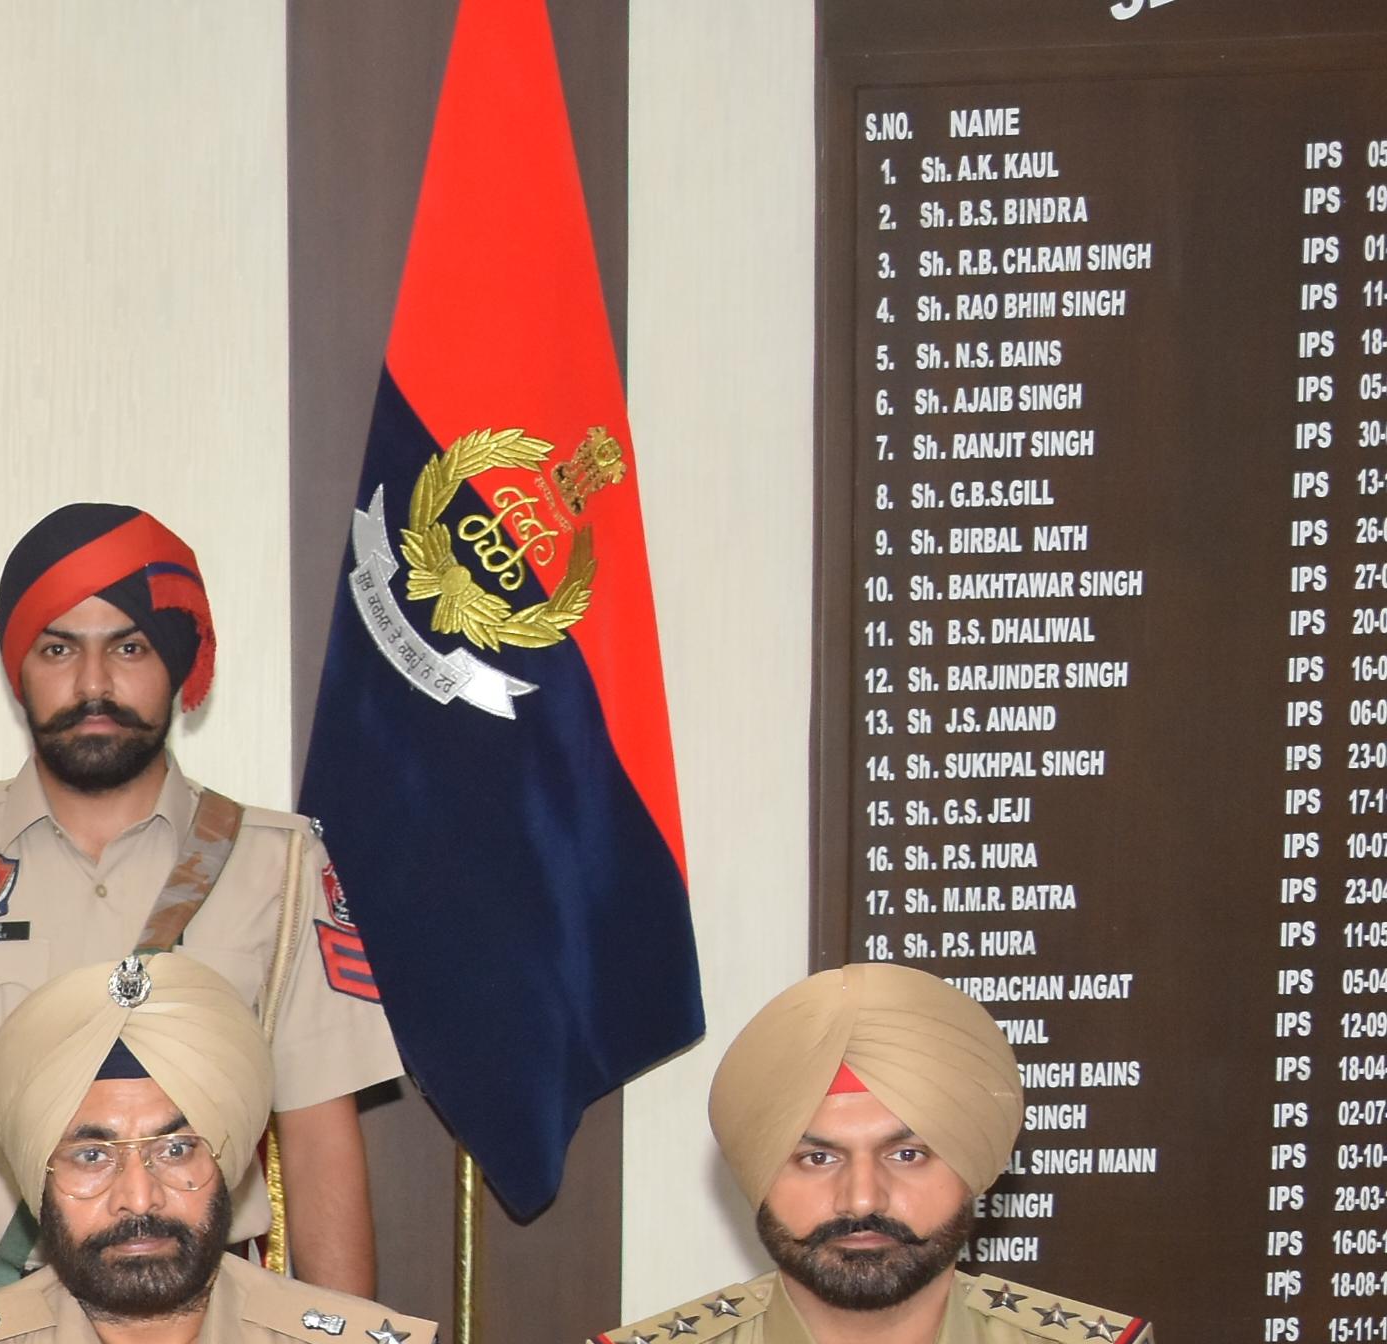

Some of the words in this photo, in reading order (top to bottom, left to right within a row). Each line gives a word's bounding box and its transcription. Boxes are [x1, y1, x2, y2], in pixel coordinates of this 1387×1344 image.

[865, 112, 913, 141] S.NO.
[950, 108, 1020, 138] NAME
[881, 159, 896, 184] 1.
[957, 154, 998, 181] A.K.
[1004, 152, 1059, 179] KAUL
[1306, 141, 1342, 169] IPS
[879, 204, 896, 230] 2.
[959, 199, 998, 226] B.S.
[1004, 196, 1088, 224] BINDRA
[1304, 186, 1340, 214] IPS
[878, 252, 896, 279] 3.
[959, 249, 998, 275] R.B.
[1087, 243, 1151, 271] SINGH
[1303, 236, 1339, 264] IPS
[876, 297, 895, 323] 4.
[957, 294, 998, 320] RAO
[1004, 292, 1056, 319] BHIM
[1062, 290, 1126, 317] SINGH
[1301, 283, 1337, 310] IPS
[876, 345, 894, 371] 5.
[955, 342, 994, 368] N.S.
[1000, 340, 1062, 367] BAINS
[1299, 331, 1334, 358] IPS
[876, 389, 894, 415] 6.
[953, 386, 1013, 413] AJAIB
[1019, 383, 1082, 411] SINGH
[1298, 376, 1333, 402] IPS
[876, 435, 894, 460] 7.
[952, 432, 1026, 459] RANJIT
[1030, 430, 1094, 457] SINGH
[1296, 422, 1331, 449] IPS
[876, 484, 894, 510] 8.
[1294, 471, 1329, 498] IPS
[876, 530, 893, 555] 9.
[949, 527, 1022, 554] BIRBAL
[1034, 525, 1088, 551] NATH
[1291, 520, 1327, 546] IPS
[865, 576, 893, 602] 10.
[948, 572, 1074, 600] BAKHTAWAR
[1079, 570, 1143, 597] SINGH
[1291, 565, 1327, 592] IPS
[865, 621, 893, 647] 11.
[948, 619, 985, 644] B.S.
[992, 617, 1095, 644] DHALIWAL
[1290, 609, 1325, 636] IPS
[865, 668, 893, 693] 12.
[947, 664, 1060, 691] BARJINDER
[1065, 662, 1128, 688] SINGH
[1288, 656, 1324, 682] IPS
[865, 709, 894, 735] 13.
[945, 707, 981, 733] J.S.
[986, 706, 1056, 732] ANAND
[1287, 700, 1322, 726] IPS
[866, 756, 895, 781] 14.
[944, 752, 1037, 778] SUKHPAL
[1041, 750, 1104, 776] SINGH
[1286, 744, 1321, 771] IPS
[867, 801, 894, 826] 15.
[944, 799, 982, 824] G.S.
[987, 797, 1030, 823] JEJI
[1286, 788, 1321, 814] IPS
[867, 846, 893, 871] 16.
[943, 844, 976, 869] P.S.
[982, 843, 1038, 868] HURA
[1284, 832, 1319, 858] IPS
[866, 890, 894, 915] 17.
[943, 886, 1006, 912] M.M.R.
[1012, 885, 1076, 910] BATRA
[1281, 877, 1316, 903] IPS
[865, 935, 894, 960] 18.
[942, 932, 975, 957] P.S.
[981, 930, 1036, 956] HURA
[1281, 921, 1315, 947] IPS
[1069, 974, 1133, 1000] JAGAT
[1278, 969, 1313, 994] IPS
[1276, 1011, 1311, 1037] IPS
[1080, 1061, 1140, 1087] BAINS
[1276, 1056, 1311, 1081] IPS
[1024, 1102, 1086, 1130] SINGH
[1031, 1149, 1093, 1174] SINGH
[1098, 1148, 1156, 1173] MANN
[992, 1193, 1053, 1218] SINGH
[977, 1237, 1038, 1262] SINGH
